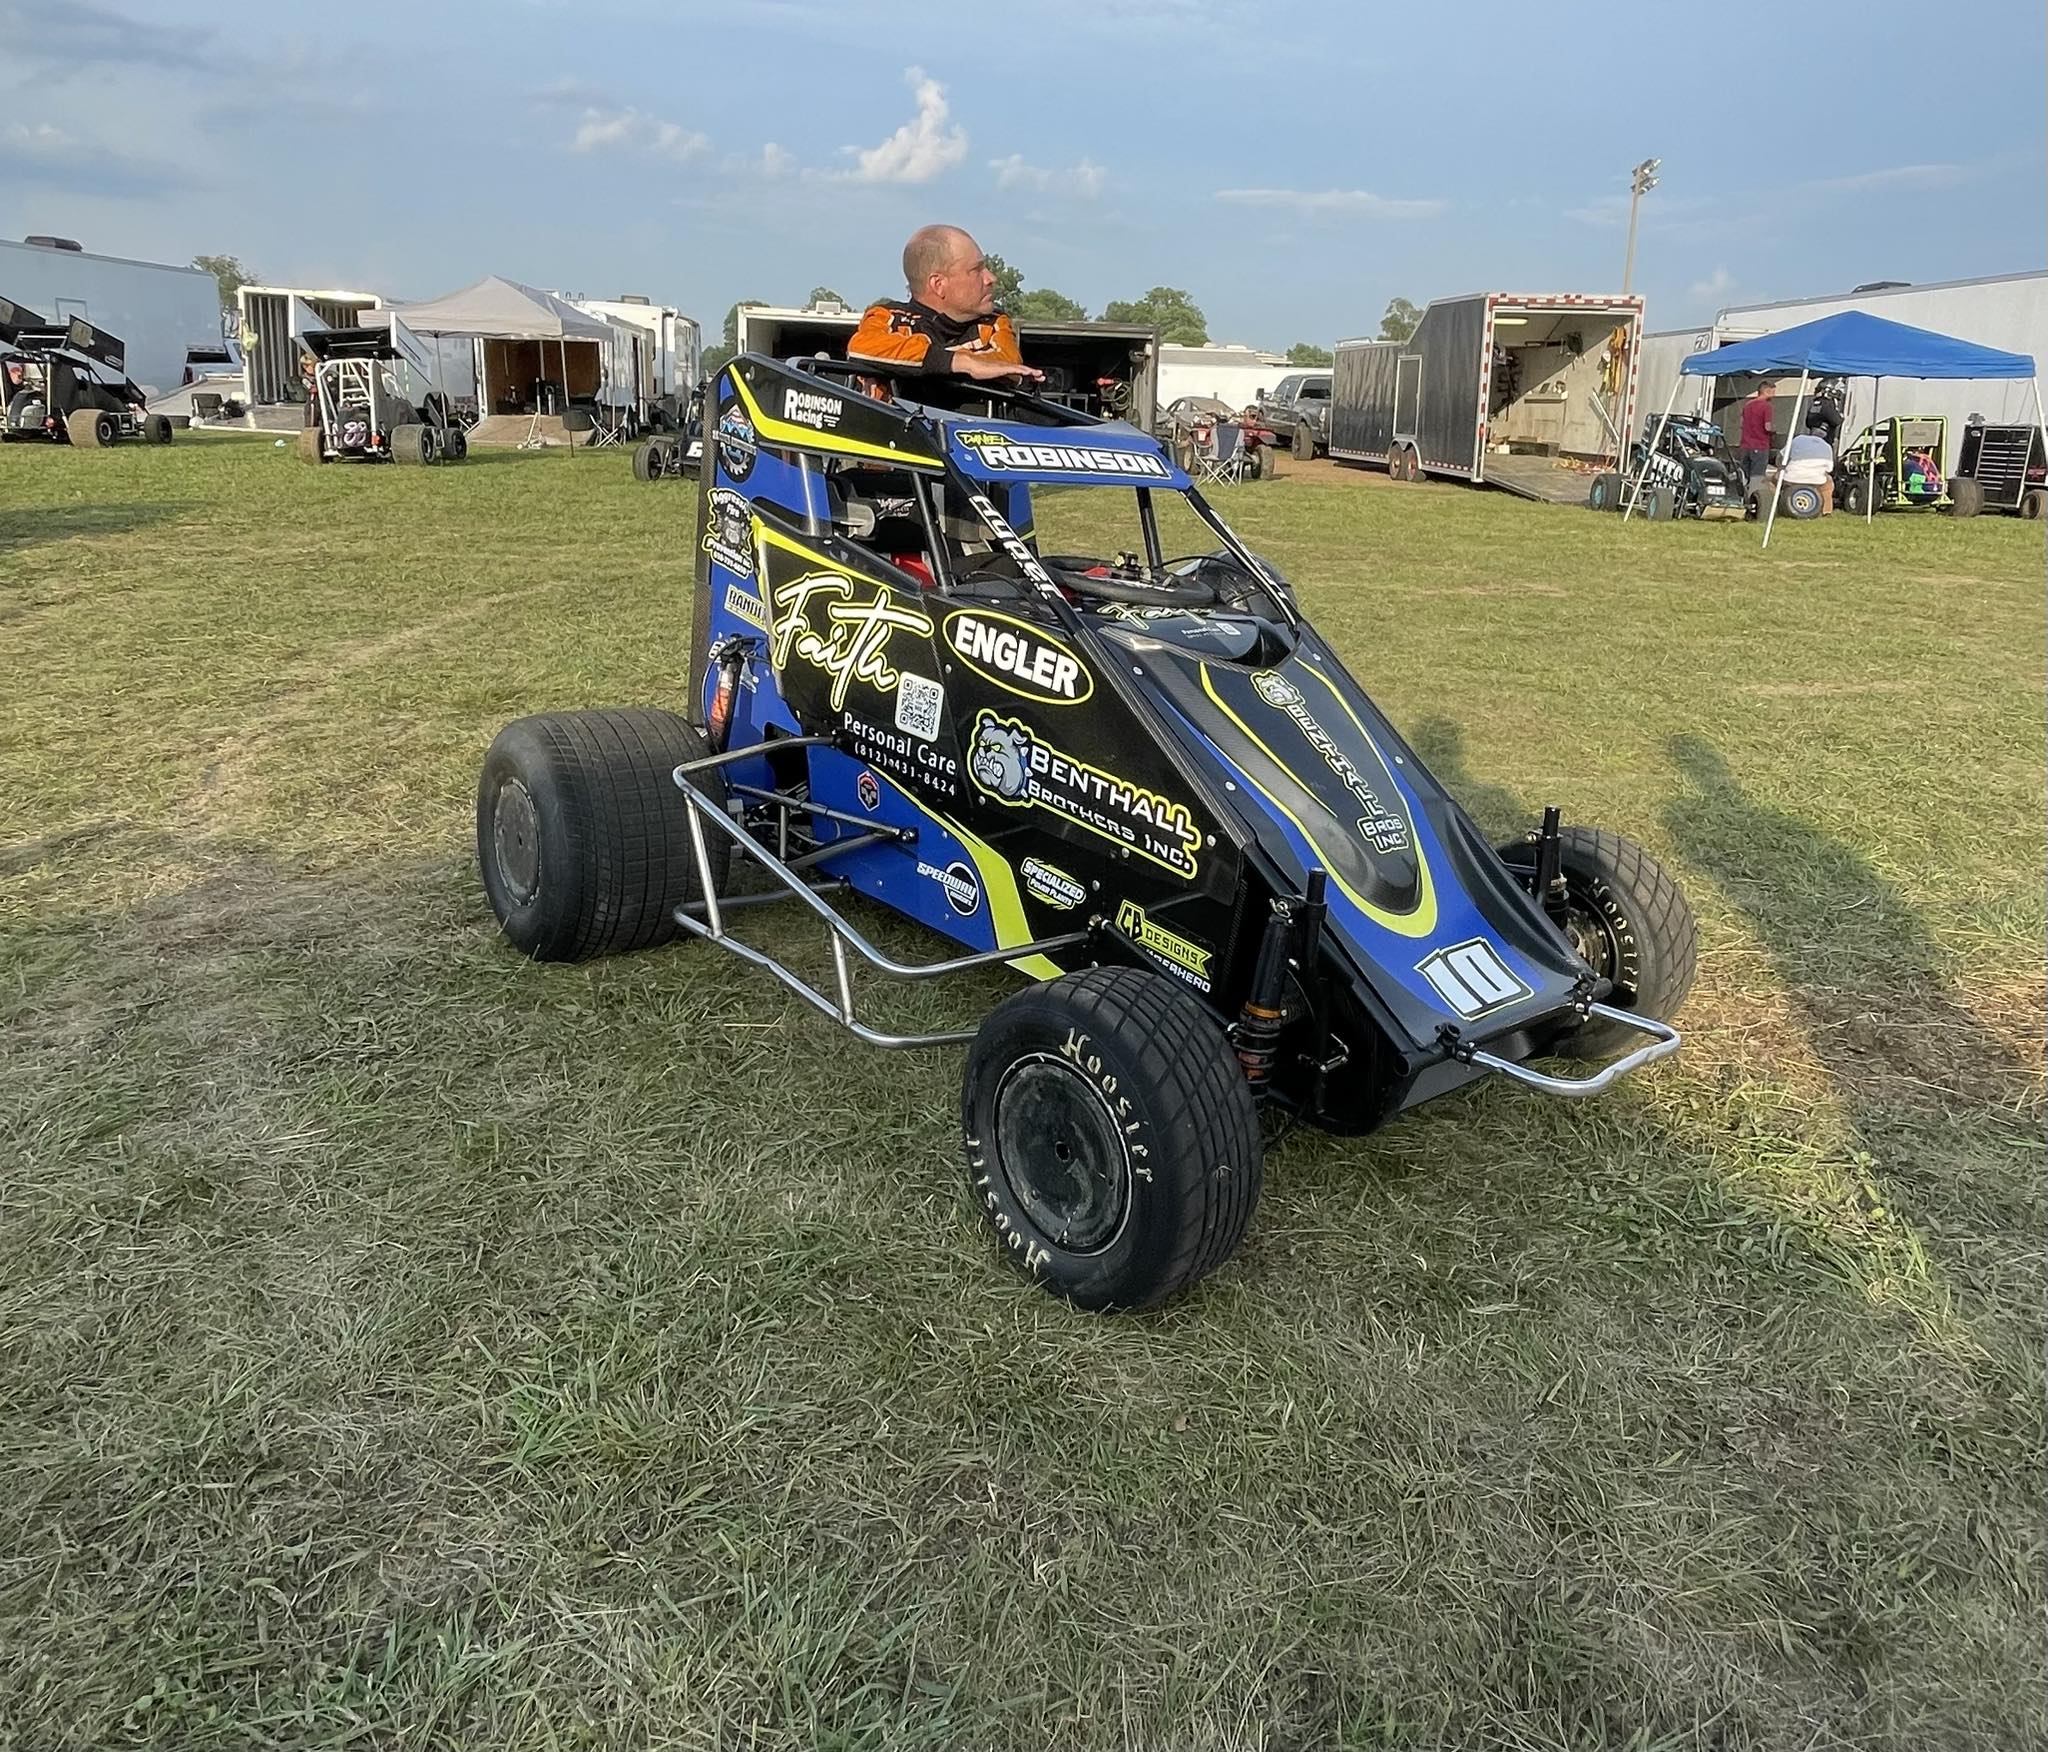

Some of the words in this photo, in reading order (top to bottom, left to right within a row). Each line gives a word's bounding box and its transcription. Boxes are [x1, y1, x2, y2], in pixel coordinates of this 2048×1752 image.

[784, 389, 843, 418] ROBINSON
[984, 445, 1169, 475] ROBINSON
[773, 573, 934, 711] Faith
[954, 615, 1078, 698] ENGLER
[844, 711, 912, 757] Personal
[917, 743, 956, 776] Care
[1286, 704, 1384, 816] BENTHALL
[1028, 779, 1136, 842] BROTHERS
[1144, 833, 1191, 870] INC.
[1030, 744, 1195, 842] BENTHALL
[1361, 818, 1403, 836] BROS
[916, 861, 977, 900] SPEEDWAY
[1023, 860, 1085, 900] SPECIALIZED
[1145, 927, 1199, 965] DESIGNS
[1423, 942, 1523, 1015] 10
